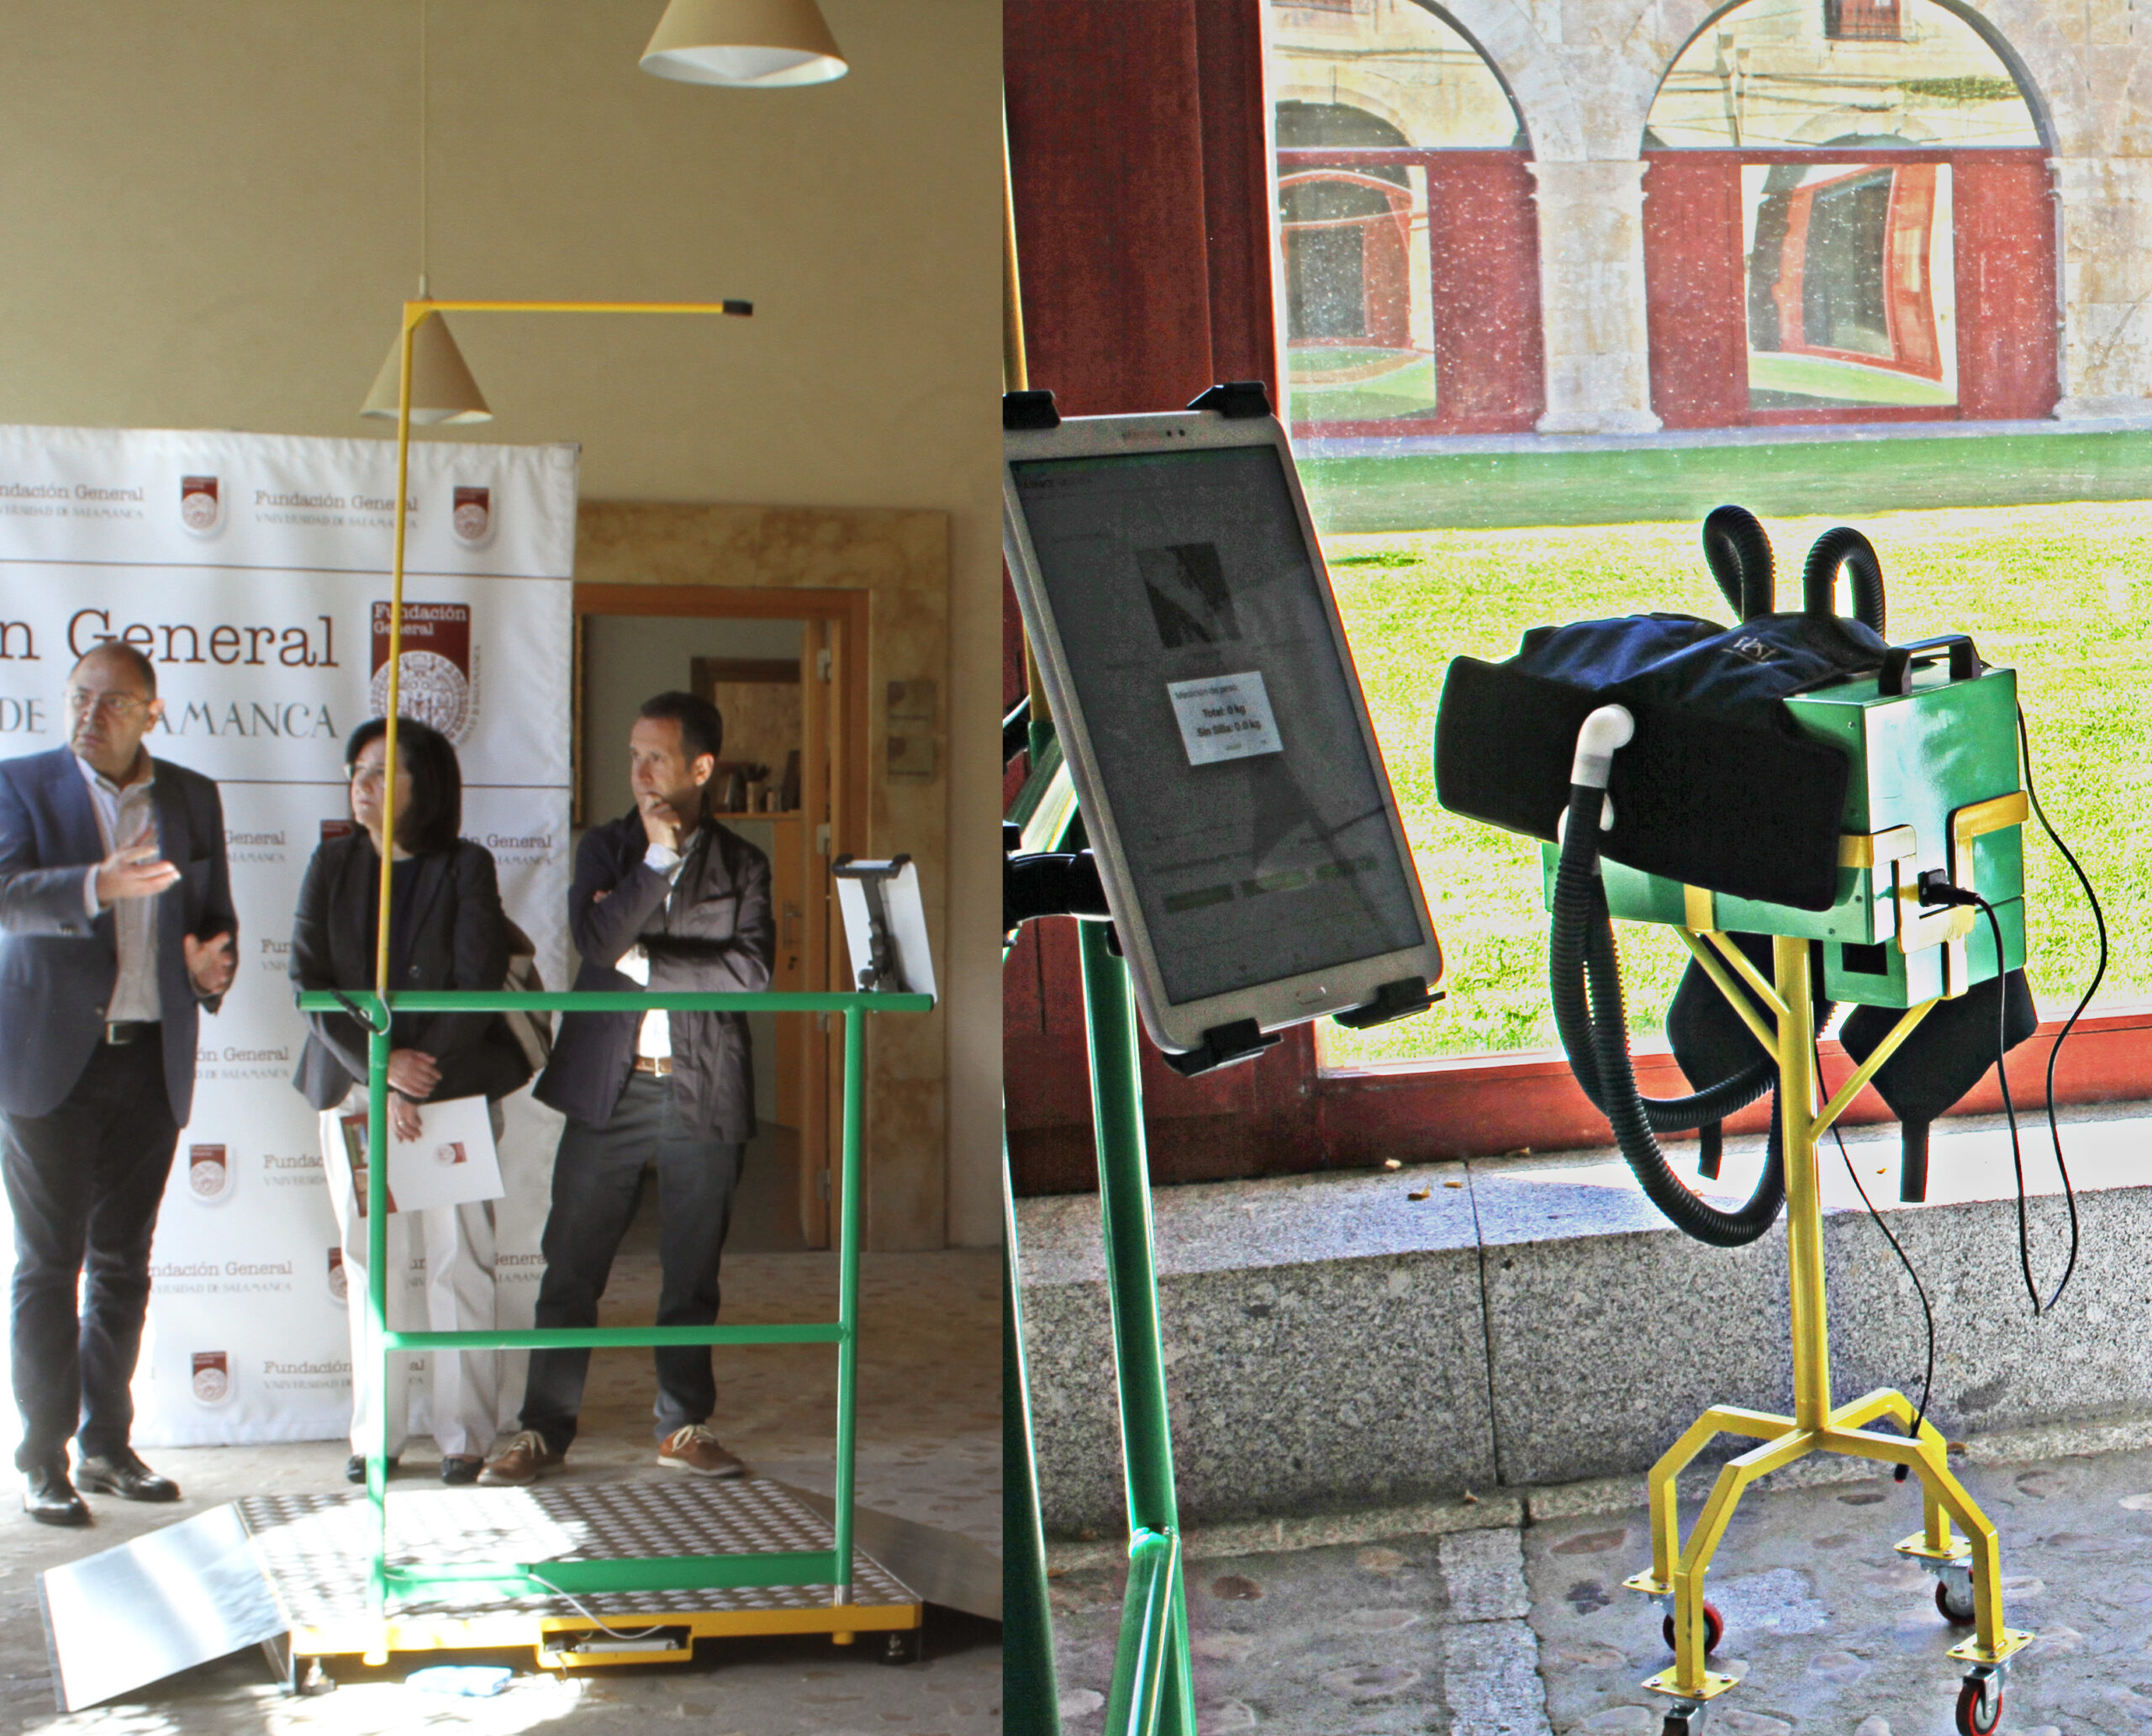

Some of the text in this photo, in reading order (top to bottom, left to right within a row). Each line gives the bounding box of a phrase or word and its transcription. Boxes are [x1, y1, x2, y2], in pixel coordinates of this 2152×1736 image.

[75, 483, 144, 500] General
[255, 490, 419, 511] Fundación Geneal
[67, 608, 339, 668] General
[0, 698, 339, 740] DE AMANCA
[487, 833, 551, 848] General
[224, 1047, 288, 1061] General
[263, 1153, 324, 1169] Fundac
[494, 1252, 546, 1266] enera
[149, 1261, 293, 1277] ndación General
[263, 1361, 351, 1374] Fundación
